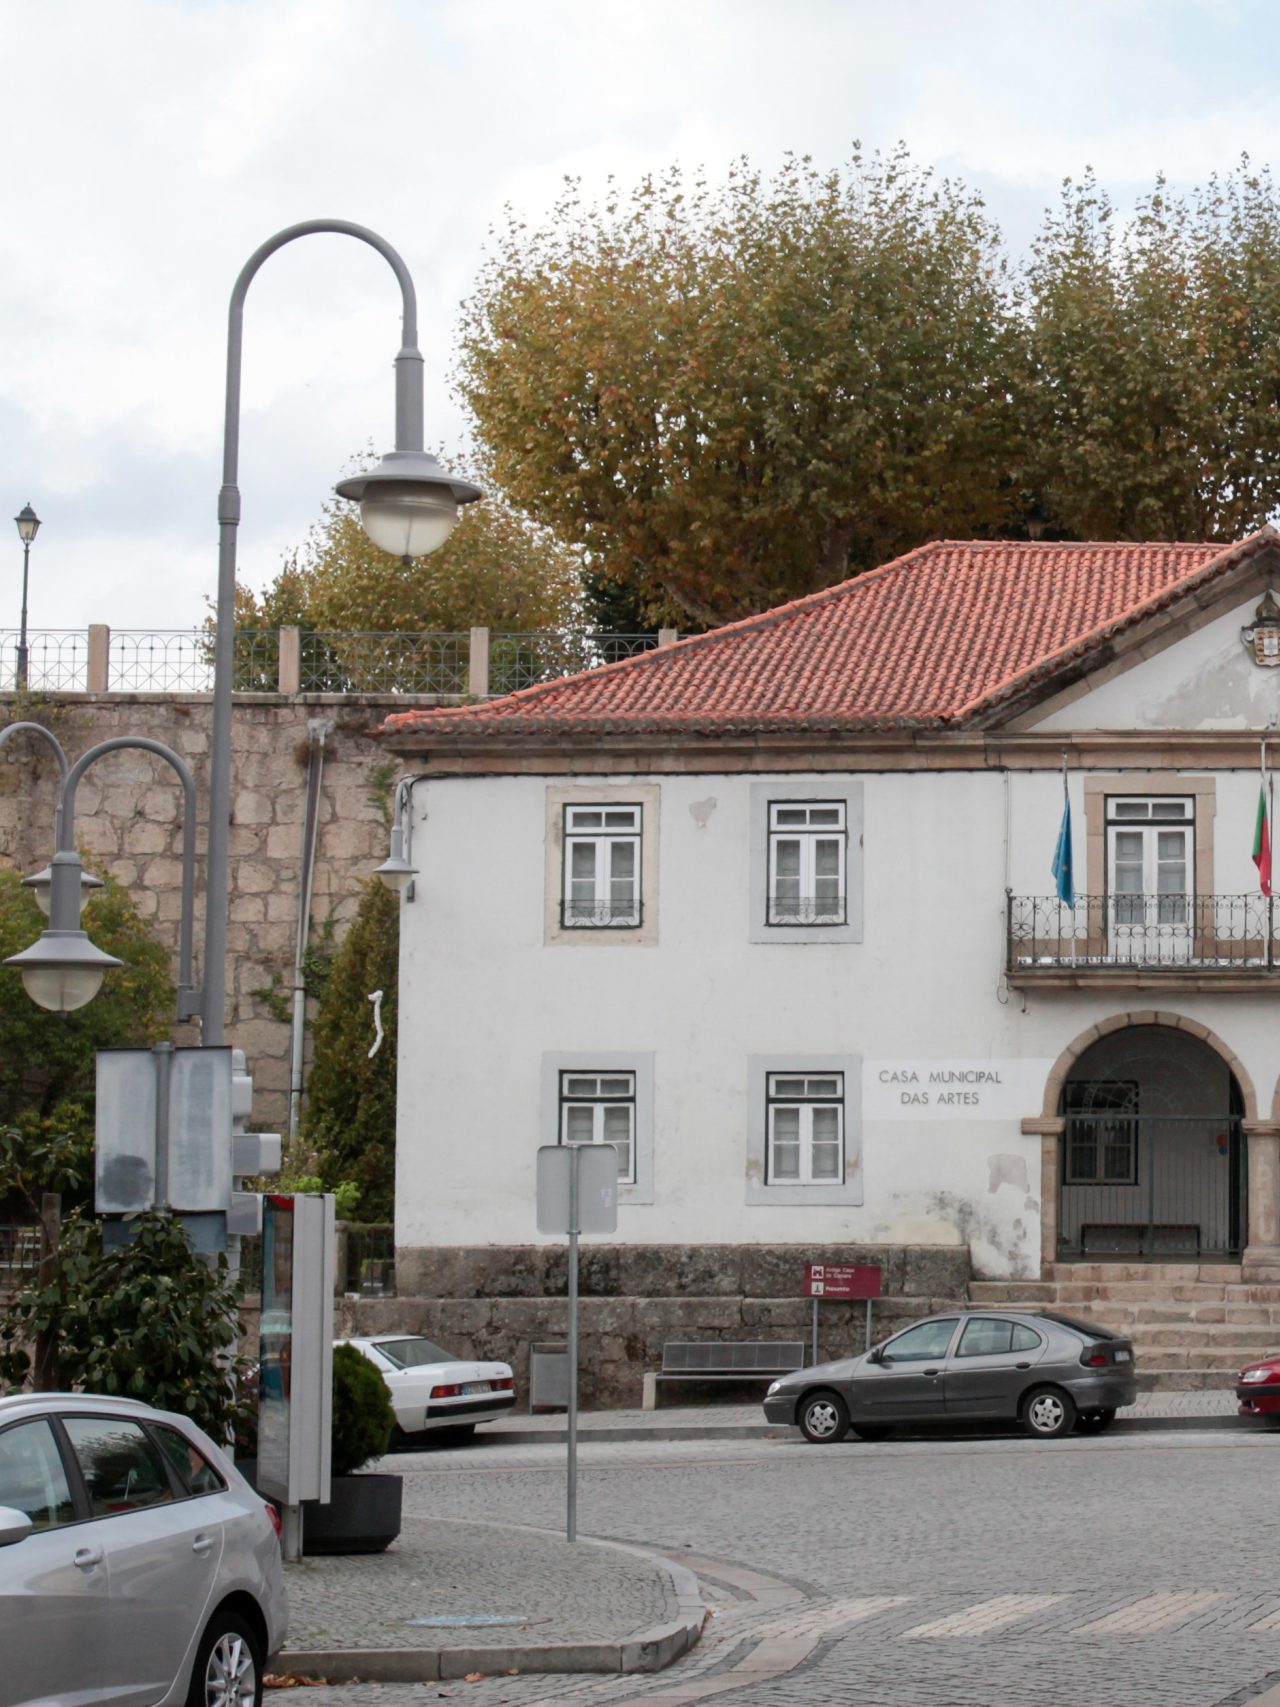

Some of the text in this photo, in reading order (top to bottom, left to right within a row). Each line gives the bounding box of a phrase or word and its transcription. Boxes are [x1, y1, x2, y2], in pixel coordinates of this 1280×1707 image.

[878, 1070, 1002, 1084] CASA MUNICIPAL
[900, 1092, 980, 1105] DAS ARTES
